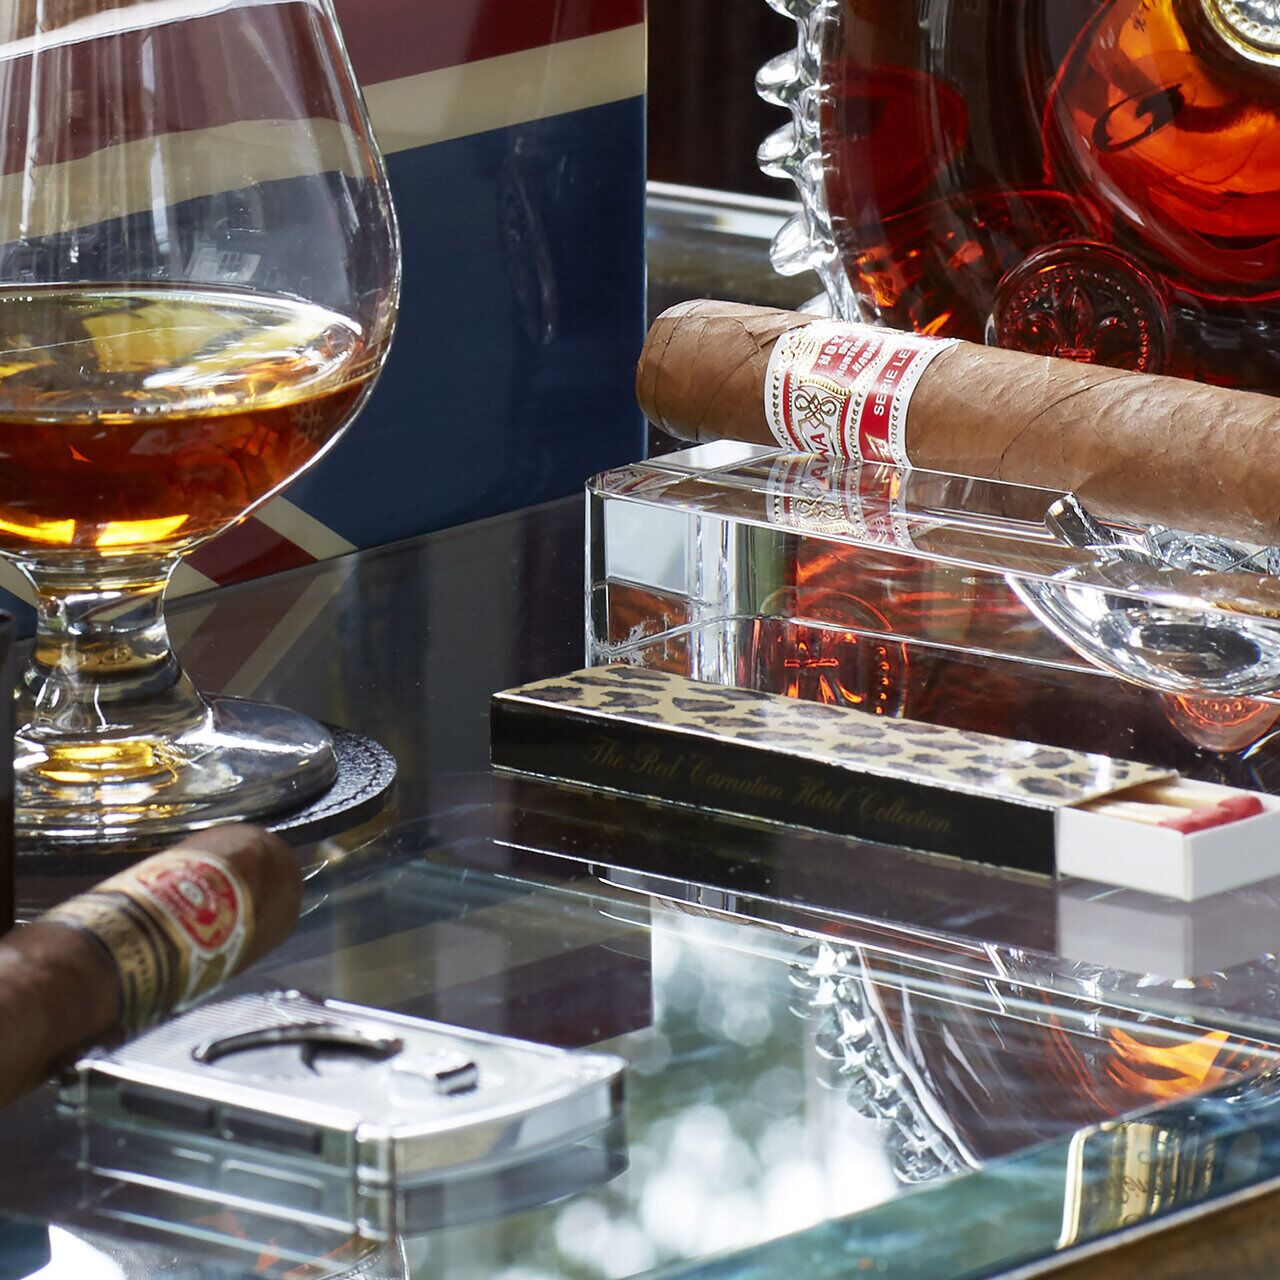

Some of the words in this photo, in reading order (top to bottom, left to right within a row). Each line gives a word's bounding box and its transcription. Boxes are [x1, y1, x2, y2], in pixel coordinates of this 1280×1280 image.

[873, 369, 899, 417] SERIE
[892, 349, 912, 367] LE
[584, 734, 624, 765] The
